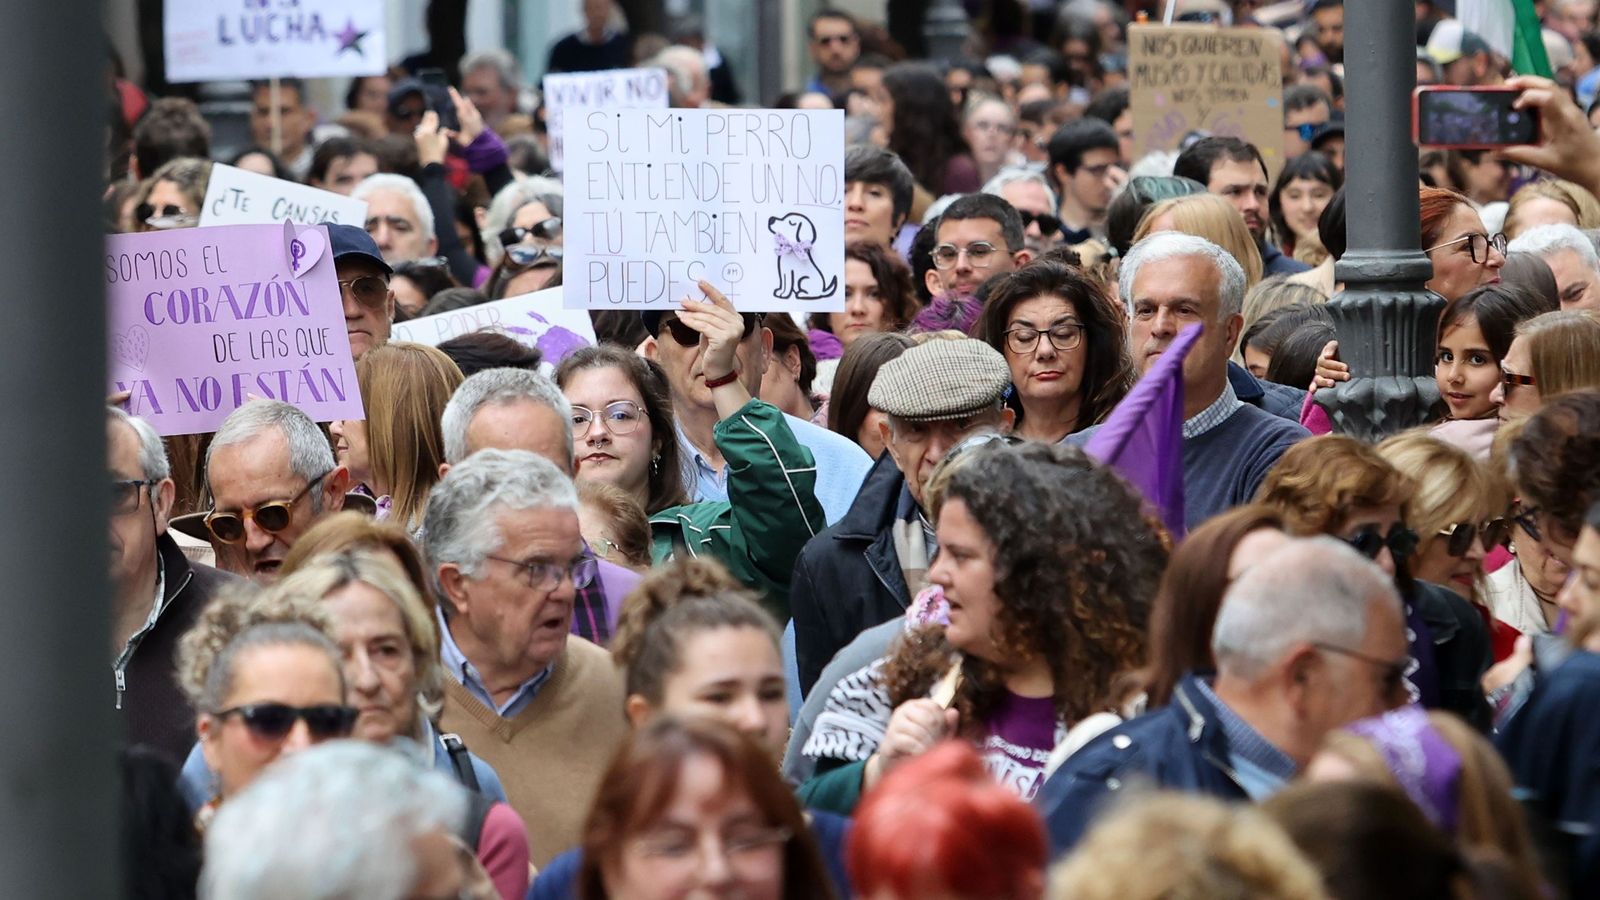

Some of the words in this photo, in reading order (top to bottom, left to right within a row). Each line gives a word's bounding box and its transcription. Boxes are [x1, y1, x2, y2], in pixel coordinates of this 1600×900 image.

[217, 12, 327, 45] LUCHA
[1143, 33, 1178, 59] NOS
[1181, 33, 1263, 57] QUIEREN
[625, 74, 663, 101] NO
[706, 113, 811, 159] PERRO
[751, 163, 784, 204] UN
[583, 208, 623, 254] TÚ
[106, 248, 188, 284] SOMOS
[203, 245, 228, 275] EL
[589, 260, 708, 304] PUEDES
[144, 274, 310, 325] CORAZÓN
[434, 306, 503, 342] PODER
[213, 332, 241, 363] DE
[249, 329, 289, 360] LAS
[295, 328, 335, 358] QUE
[115, 379, 164, 415] YA
[176, 375, 222, 413] NO
